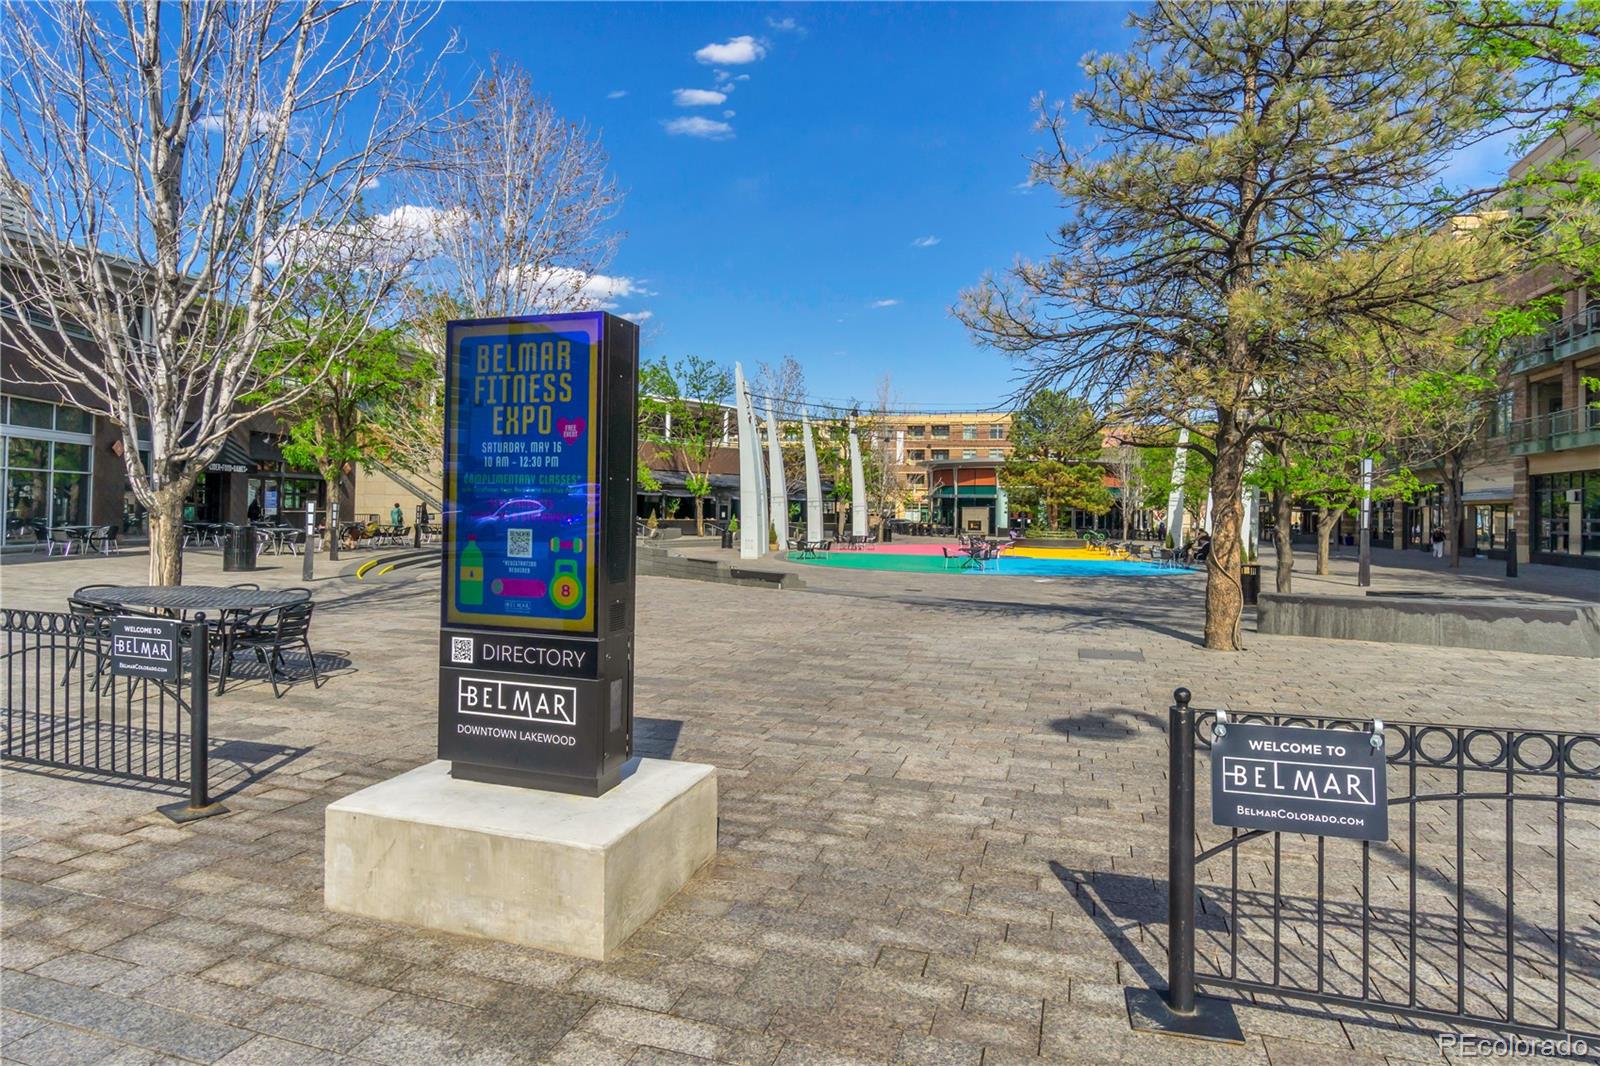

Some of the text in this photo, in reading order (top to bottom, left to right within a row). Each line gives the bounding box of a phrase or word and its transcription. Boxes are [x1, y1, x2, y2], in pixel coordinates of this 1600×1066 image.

[477, 341, 571, 373] BELMAR
[474, 373, 573, 404] FITNESS
[492, 405, 552, 435] EXPO
[530, 441, 550, 453] MAY
[553, 441, 562, 453] 16
[484, 456, 493, 468] 10
[495, 456, 509, 468] AM
[519, 456, 542, 468] 12:30
[545, 456, 559, 468] PM
[561, 584, 570, 597] 8
[124, 625, 152, 634] WELCOME
[119, 637, 170, 661] BELMAR
[482, 643, 586, 668] DIRECTORY
[467, 682, 571, 723] BELMAR
[457, 723, 576, 746] DOWNTOWN LAKEWOOD
[1248, 739, 1346, 757] WELCOME TO
[1233, 761, 1370, 804] BELMAR
